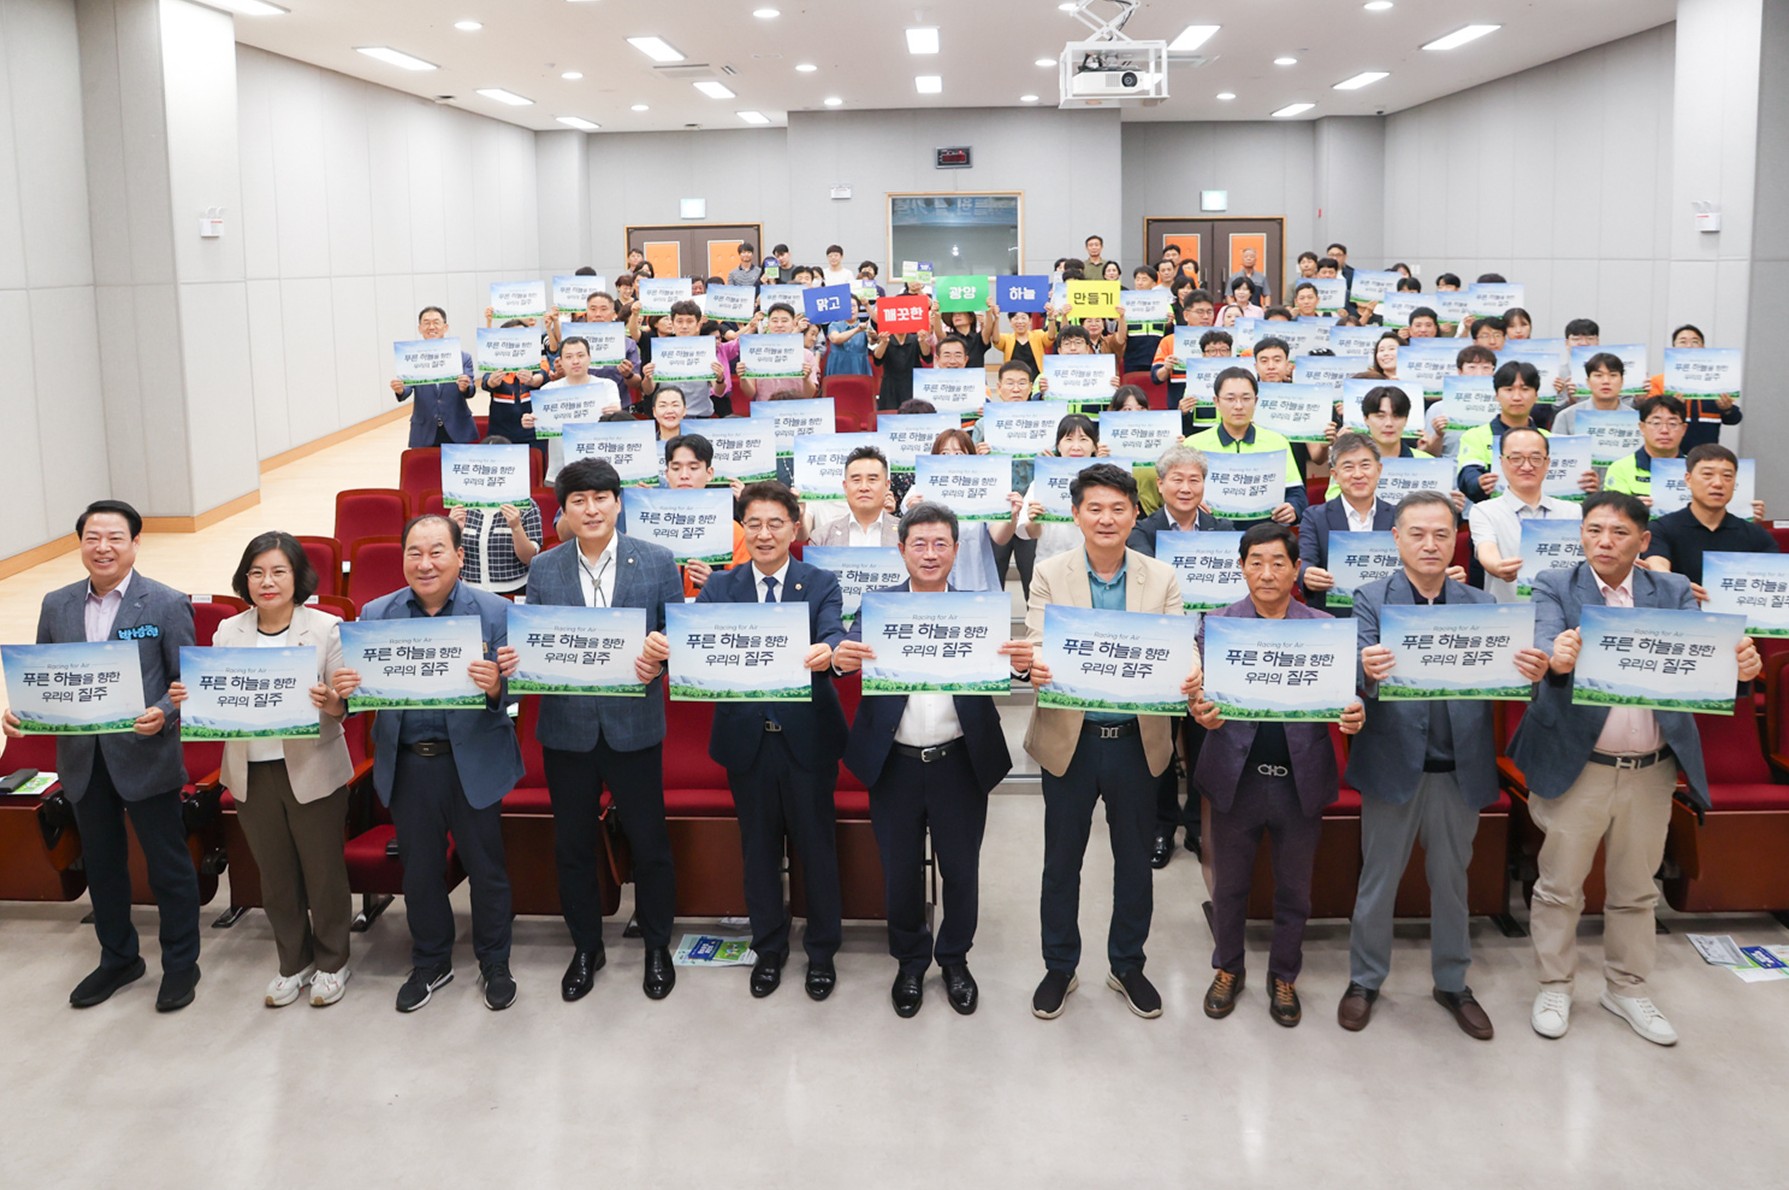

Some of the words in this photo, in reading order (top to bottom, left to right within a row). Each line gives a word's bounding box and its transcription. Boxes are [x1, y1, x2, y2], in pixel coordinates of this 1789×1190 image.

[949, 286, 976, 300] 광양
[1009, 286, 1036, 300] 하늘
[1073, 292, 1113, 305] 만들기
[816, 296, 840, 312] 맑고
[883, 306, 923, 321] 깨끗한
[1280, 399, 1305, 410] 하늘을
[733, 450, 751, 461] 질주
[1211, 473, 1230, 484] 푸른
[1391, 477, 1419, 489] 하늘을
[1249, 485, 1267, 496] 질주
[640, 512, 660, 524] 푸른
[664, 513, 695, 525] 하늘을
[653, 527, 679, 538] 우리의
[682, 527, 704, 539] 질주
[1172, 556, 1196, 568] 푸른
[1200, 556, 1233, 569] 하늘을
[846, 570, 879, 582] 하늘을
[1218, 571, 1243, 584] 질주
[1721, 578, 1747, 591] 푸른
[1751, 579, 1787, 592] 하늘을
[883, 624, 913, 639] 푸른
[918, 623, 960, 639] 하늘을
[964, 626, 988, 638] 향한
[527, 634, 555, 647] 푸른
[560, 634, 599, 648] 하늘을
[603, 638, 624, 649] 향한
[687, 634, 715, 648] 푸른
[721, 633, 761, 648] 하늘을
[765, 636, 788, 647] 향한
[1402, 635, 1433, 649] 푸른
[1439, 634, 1482, 648] 하늘을
[1486, 636, 1510, 647] 향한
[1600, 636, 1634, 652] 푸른
[1639, 638, 1685, 655] 하늘을
[1689, 644, 1715, 657] 향한
[363, 648, 391, 661] 푸른
[397, 646, 436, 660] 하늘을
[440, 647, 462, 658] 향한
[902, 645, 937, 657] 우리의
[943, 642, 972, 657] 질주
[1063, 639, 1094, 656] 푸른
[1099, 642, 1142, 659] 하늘을
[1145, 648, 1169, 661] 향한
[545, 653, 578, 663] 우리의
[583, 652, 610, 665] 질주
[706, 655, 740, 666] 우리의
[745, 652, 773, 666] 질주
[1226, 650, 1257, 666] 푸른
[1263, 651, 1306, 667] 하늘을
[1310, 654, 1334, 666] 향한
[1421, 655, 1457, 666] 우리의
[1462, 651, 1493, 665] 질주
[383, 665, 416, 676] 우리의
[421, 662, 448, 676] 질주
[1081, 662, 1117, 676] 우리의
[1122, 663, 1153, 678] 질주
[1618, 658, 1658, 671] 우리의
[1663, 659, 1696, 675] 질주
[23, 673, 49, 686] 푸른
[54, 672, 93, 686] 하늘을
[98, 672, 120, 683] 향한
[200, 676, 226, 690] 푸른
[231, 676, 270, 690] 하늘을
[274, 678, 296, 689] 향한
[1245, 672, 1282, 684] 우리의
[1287, 671, 1318, 685] 질주
[42, 692, 73, 702] 우리의
[79, 687, 107, 702] 질주
[217, 696, 249, 707] 우리의
[254, 693, 282, 707] 질주
